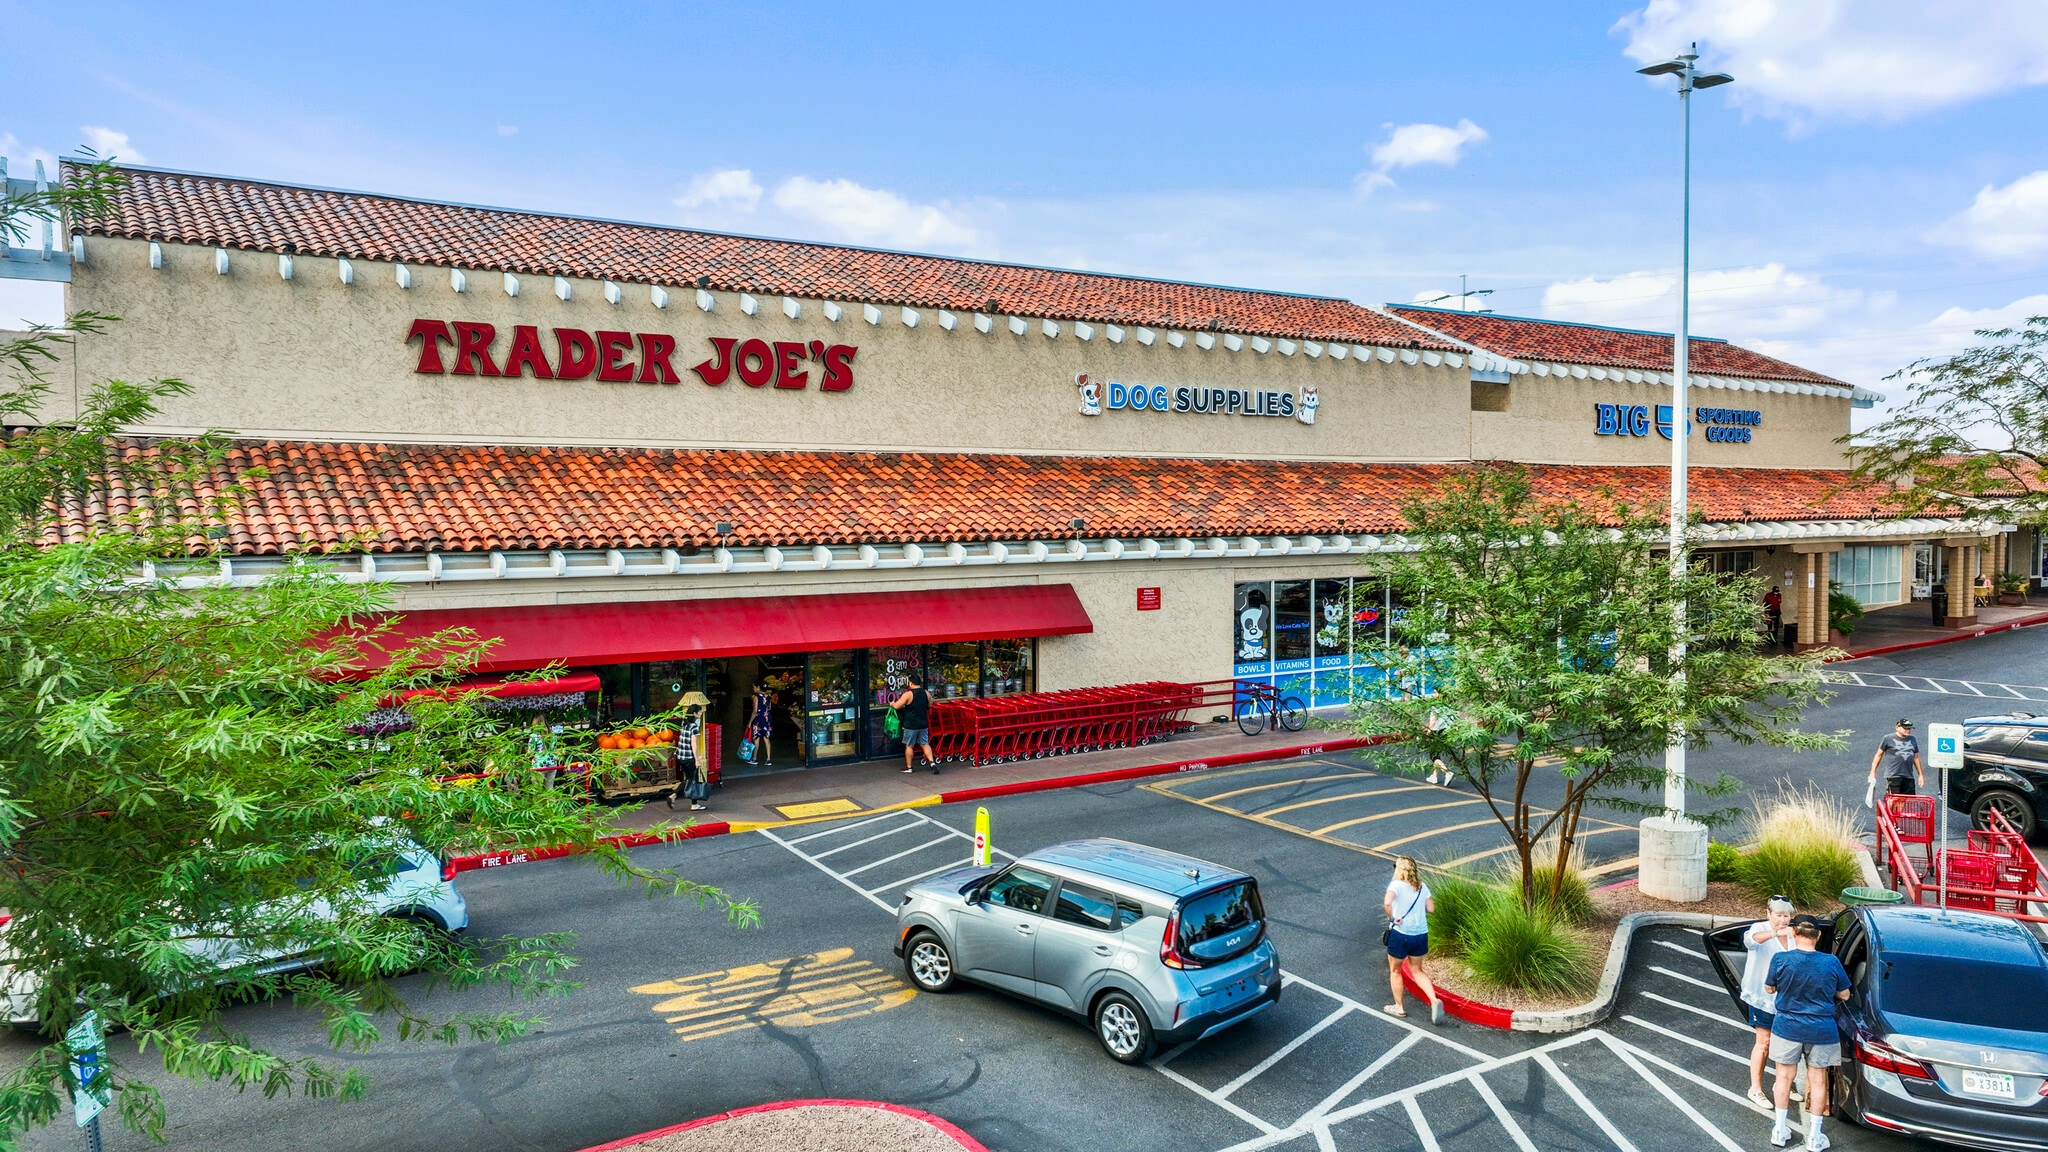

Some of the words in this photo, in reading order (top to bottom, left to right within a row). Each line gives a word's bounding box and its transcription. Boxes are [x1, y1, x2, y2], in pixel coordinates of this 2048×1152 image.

[404, 318, 681, 384] TRADER
[690, 336, 859, 391] JOE'S
[1107, 382, 1169, 412] DOG
[1173, 385, 1295, 417] SUPPLIES
[1595, 403, 1650, 437] BIG
[1696, 406, 1762, 425] SPORTING
[1706, 426, 1752, 443] GOODS
[1238, 664, 1266, 674] BOWLS
[1275, 660, 1310, 670] VITAMINS
[1321, 657, 1342, 666] FOOD
[482, 856, 502, 868] FIRE
[505, 853, 528, 865] LANE
